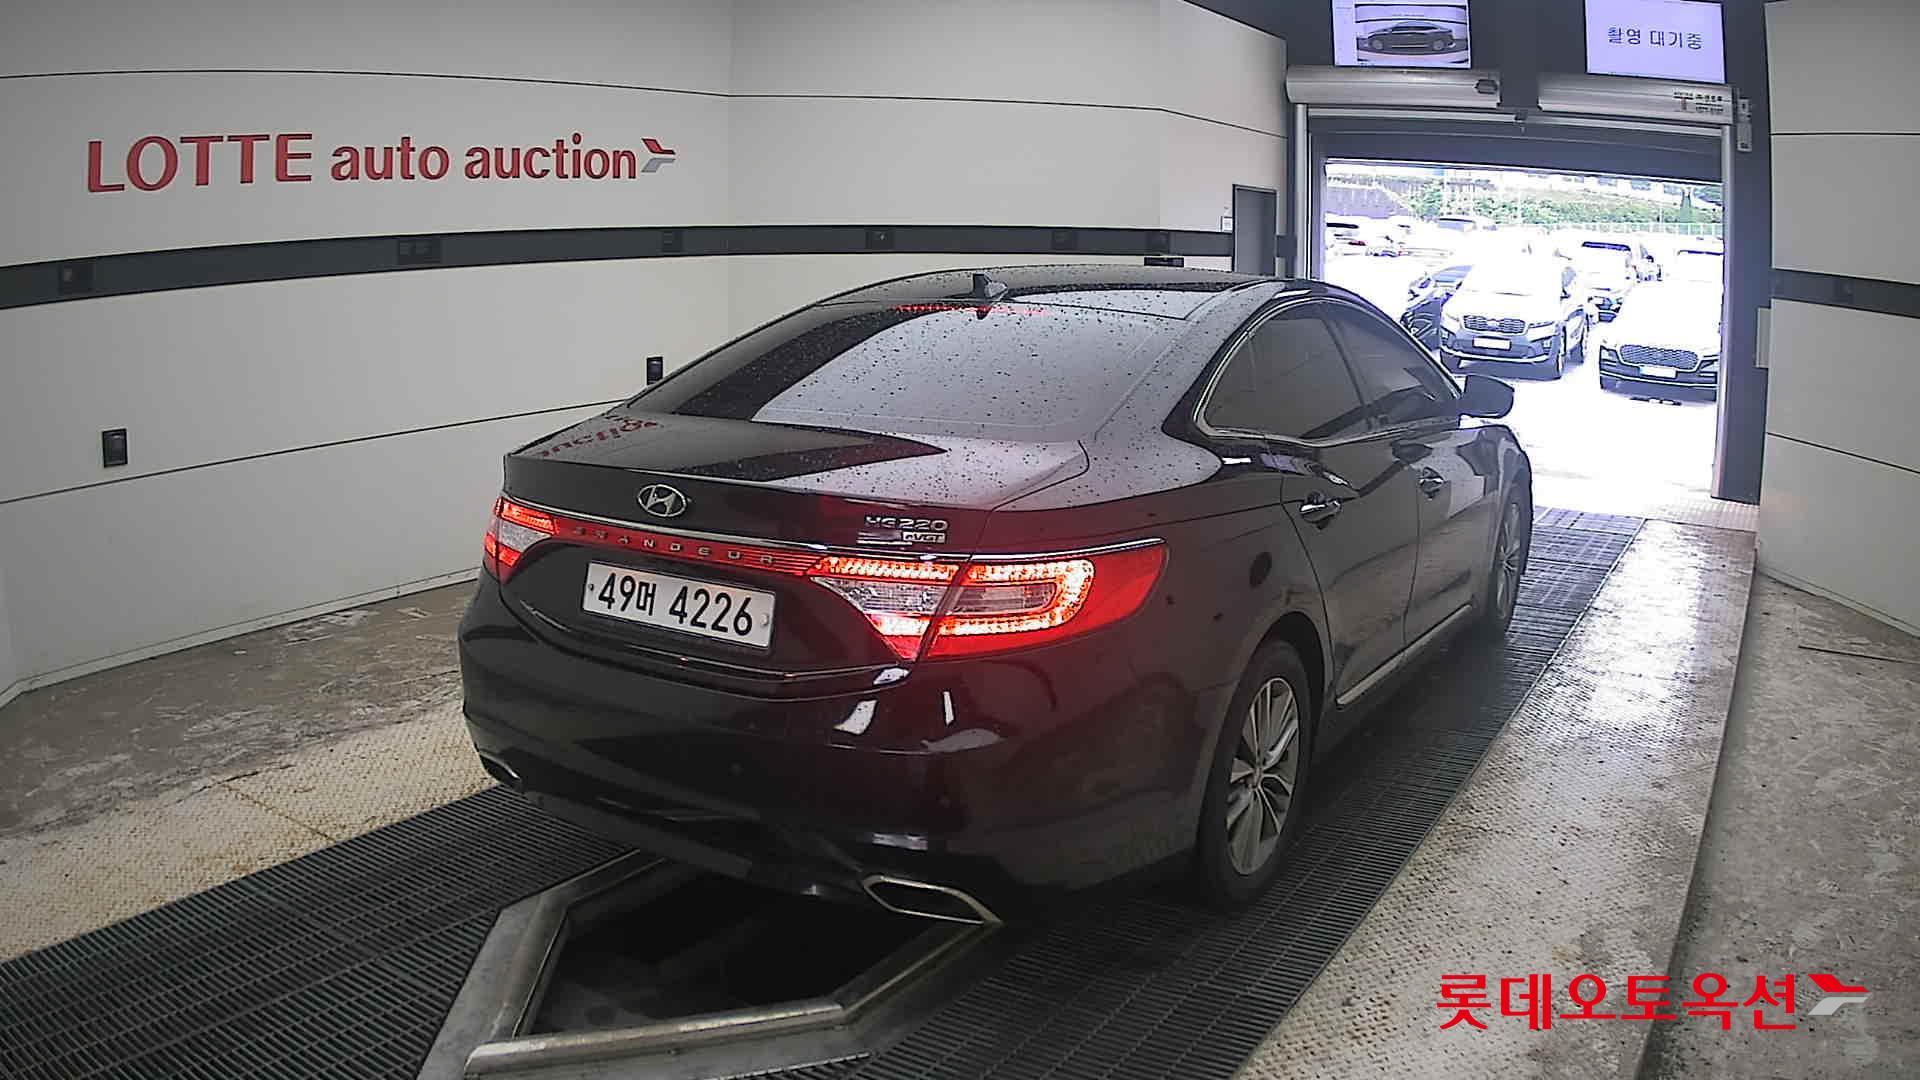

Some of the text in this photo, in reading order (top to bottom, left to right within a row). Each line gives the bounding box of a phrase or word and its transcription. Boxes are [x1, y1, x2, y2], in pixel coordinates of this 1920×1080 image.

[1650, 30, 1702, 50] 대기중
[87, 132, 637, 193] LOTTE auto auction
[598, 572, 754, 636] 49머 4226
